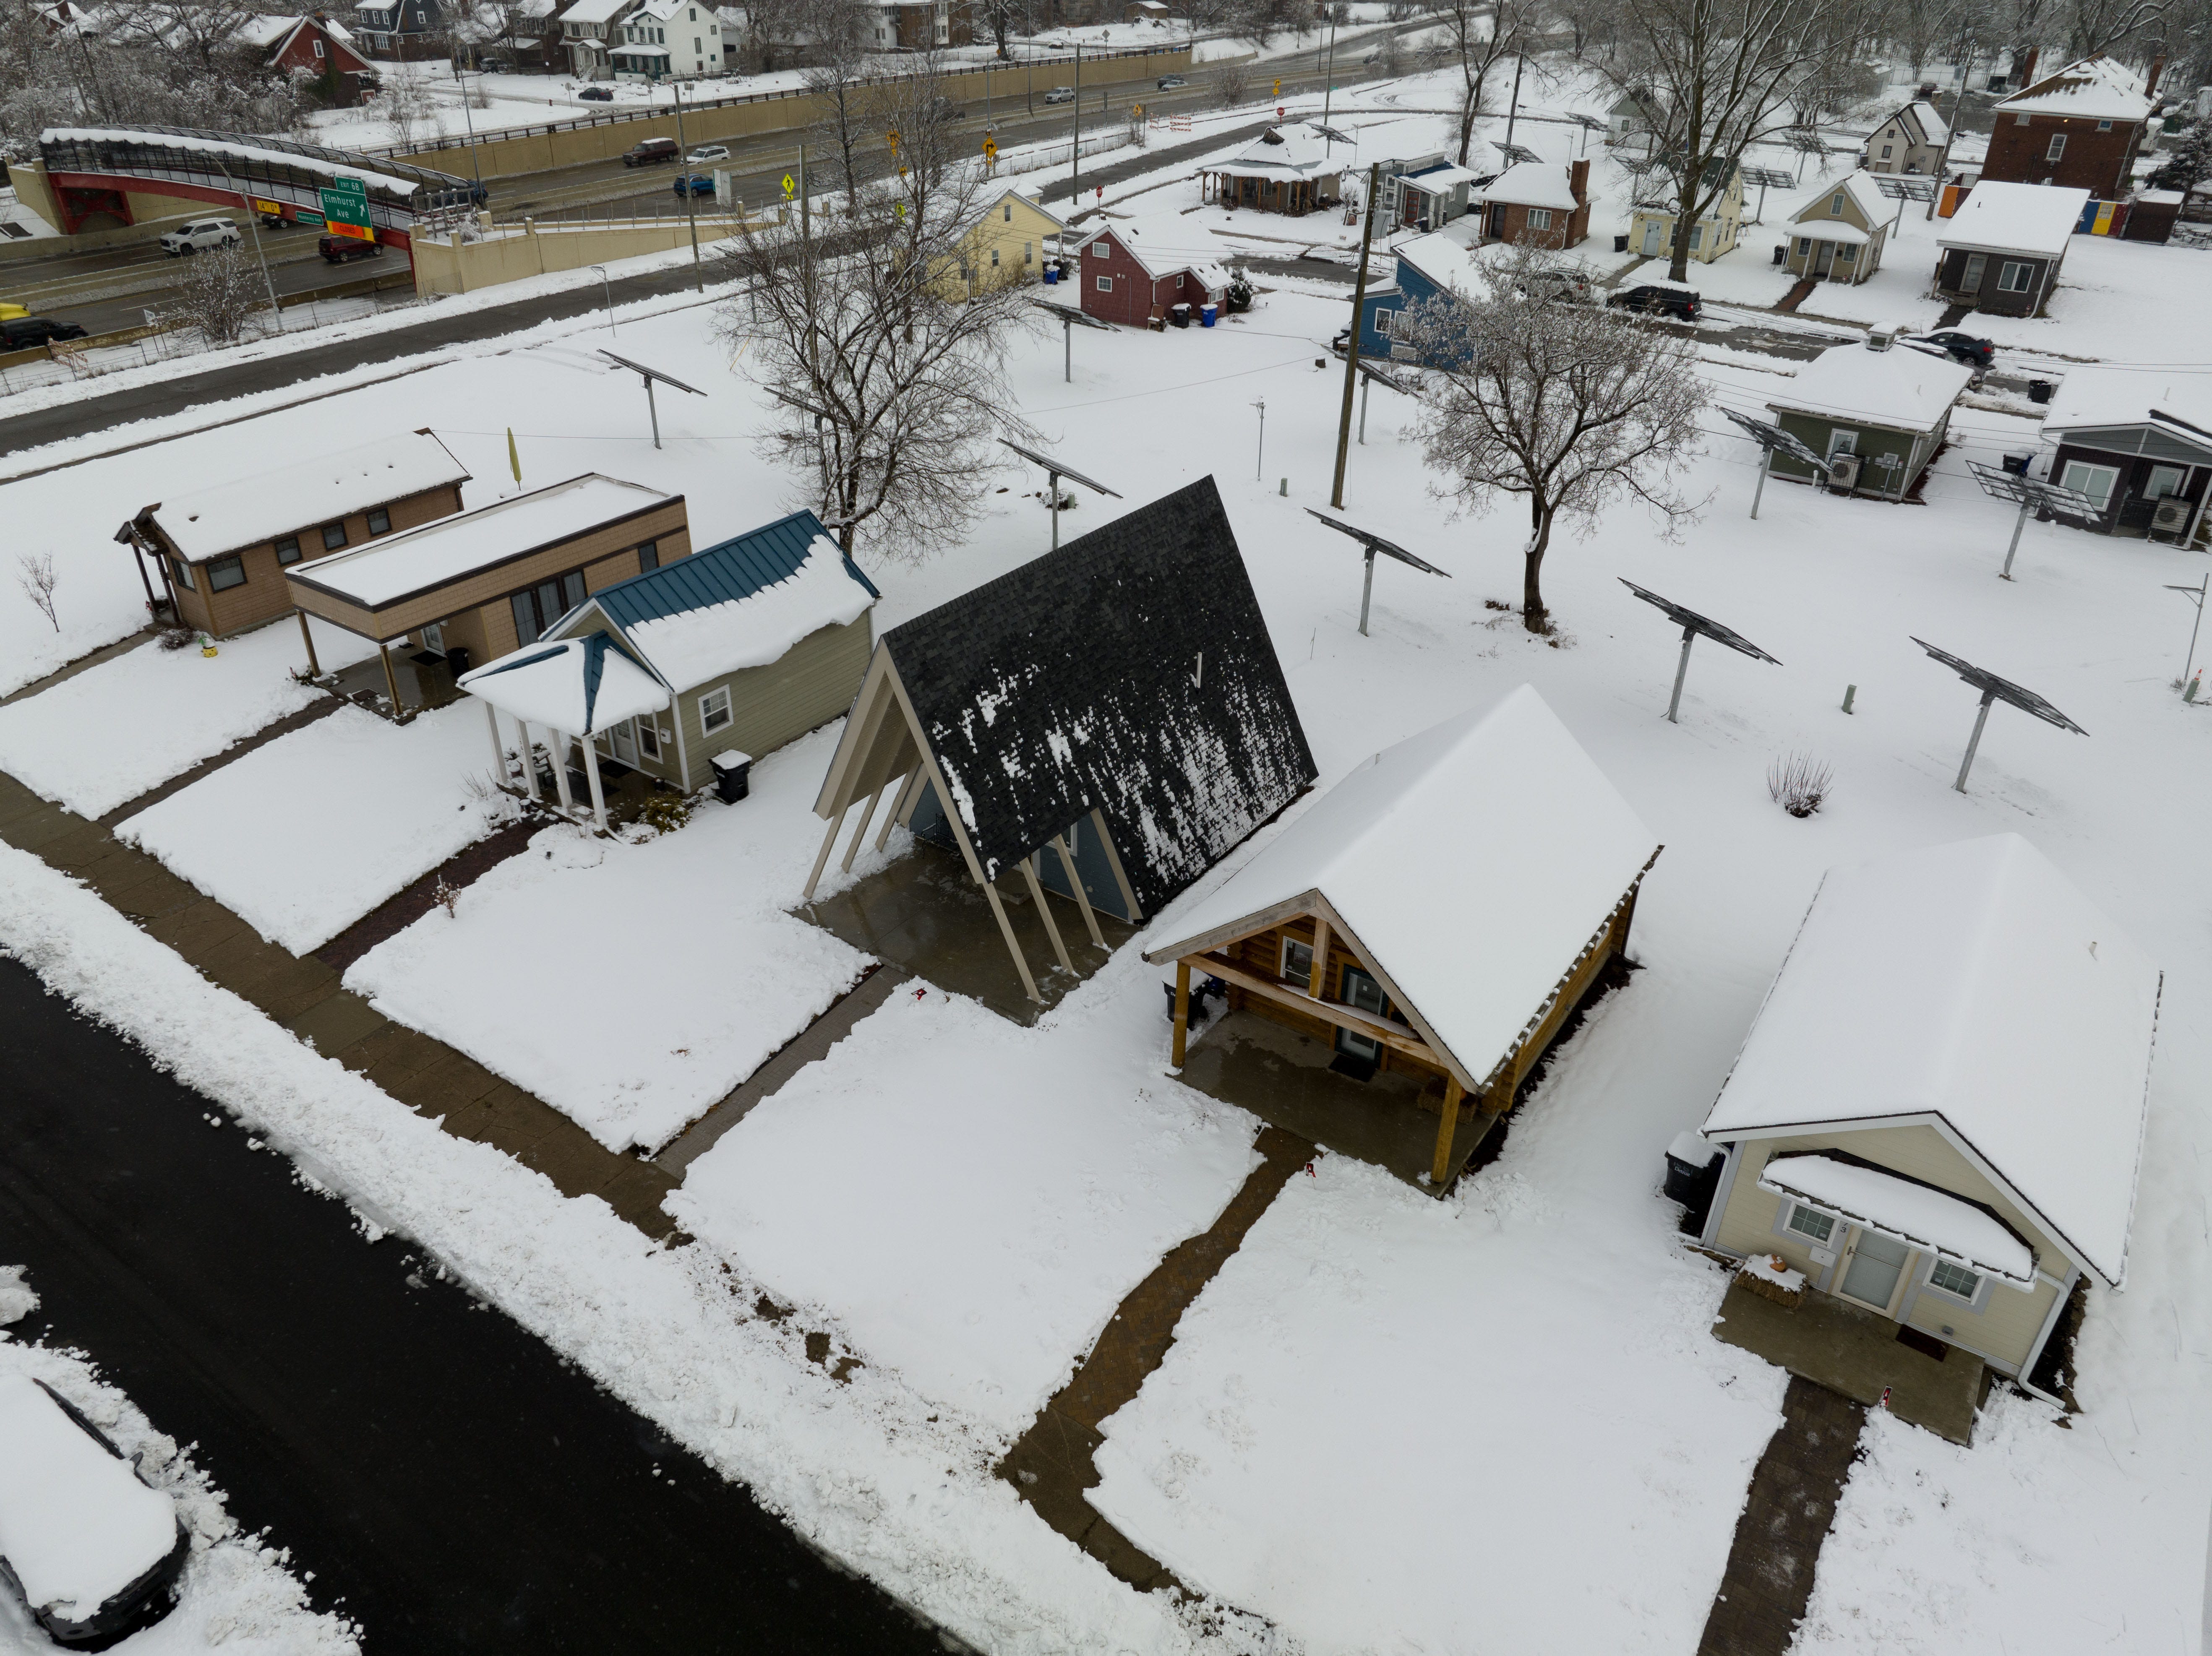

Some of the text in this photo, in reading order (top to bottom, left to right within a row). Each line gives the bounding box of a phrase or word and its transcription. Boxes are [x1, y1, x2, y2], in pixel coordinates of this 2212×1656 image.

[351, 182, 360, 191] 6B
[323, 194, 356, 207] Elmhurst
[337, 209, 349, 219] Ave
[339, 225, 356, 234] CLOSED
[1675, 1166, 1690, 1177] Detroit
